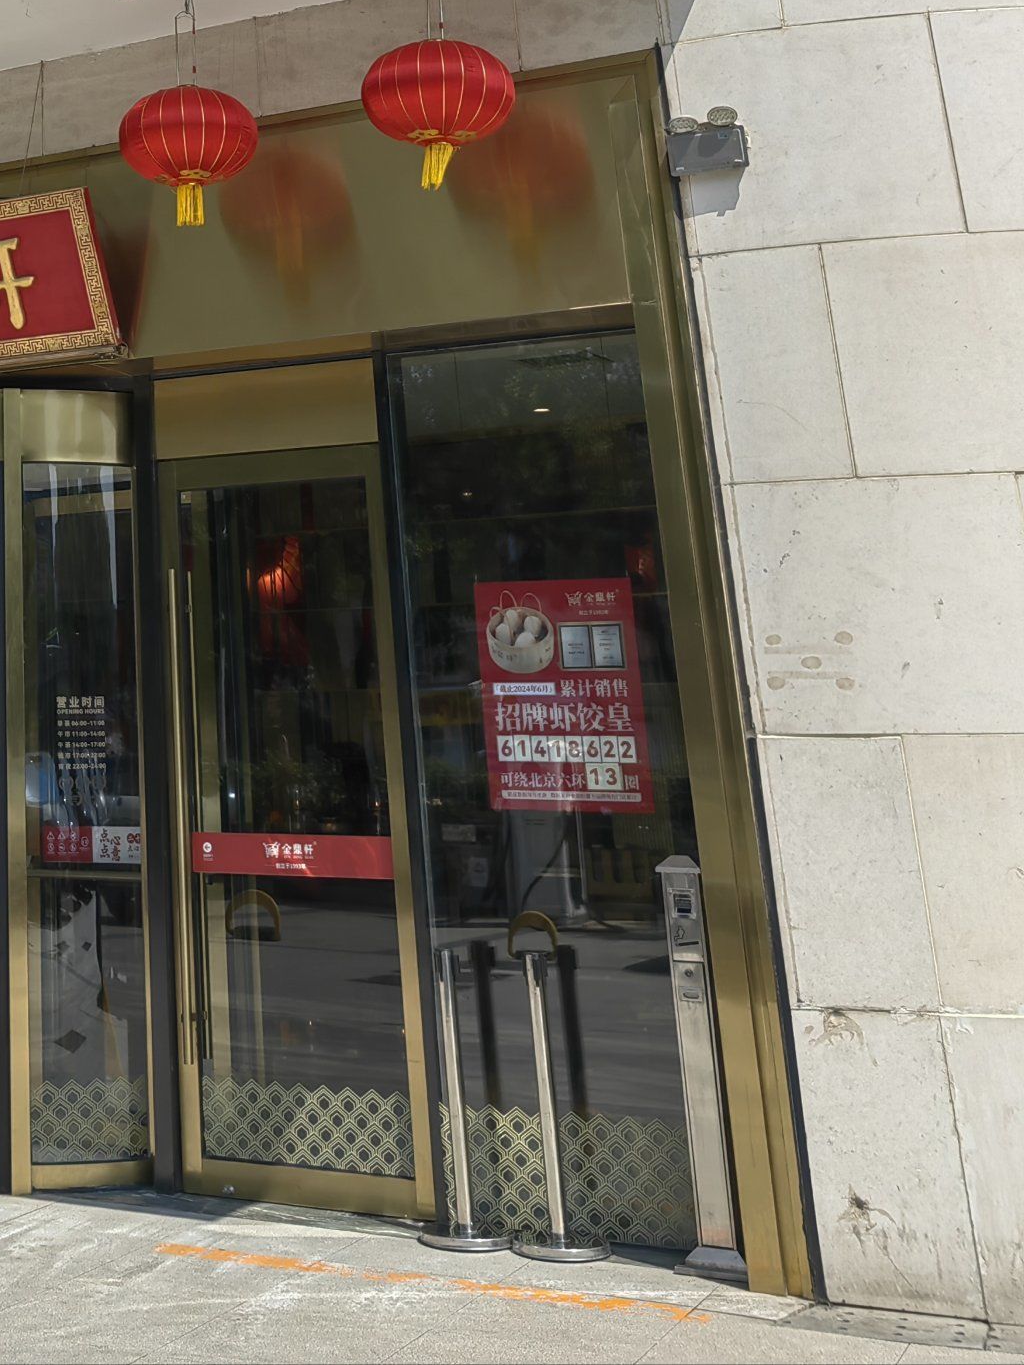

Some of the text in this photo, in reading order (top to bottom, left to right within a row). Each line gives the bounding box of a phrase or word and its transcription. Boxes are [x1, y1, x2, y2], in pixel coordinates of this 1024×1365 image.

[559, 678, 630, 698] 累计销售
[56, 696, 105, 708] 营业时间
[495, 702, 634, 732] 招牌虾饺皇
